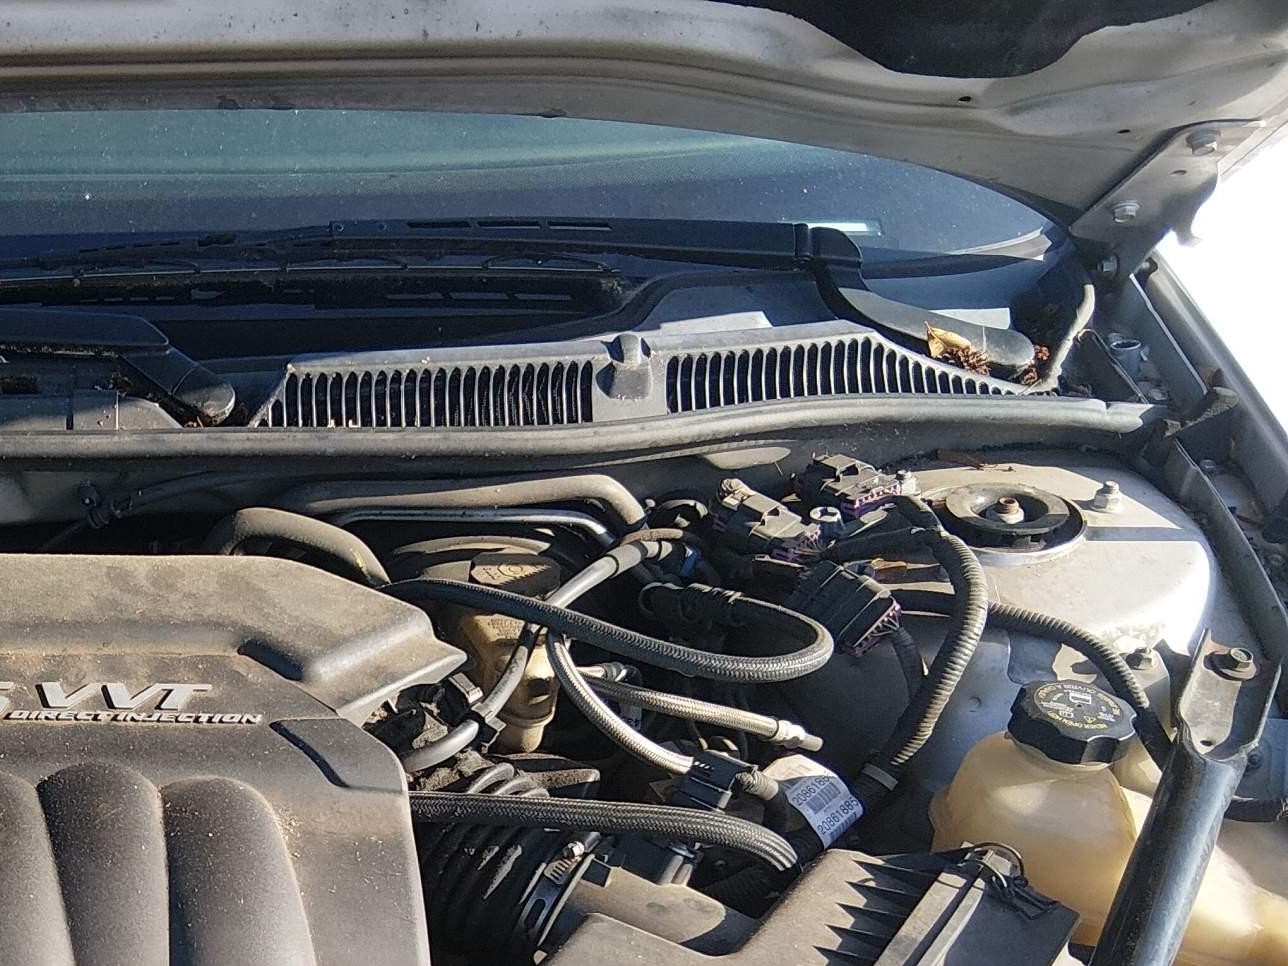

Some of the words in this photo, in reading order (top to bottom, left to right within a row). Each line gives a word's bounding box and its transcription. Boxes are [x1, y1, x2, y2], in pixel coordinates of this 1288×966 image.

[34, 681, 212, 711] VVT
[4, 710, 111, 722] DIRECT
[111, 711, 263, 725] INJECTION
[817, 796, 859, 835] 20861885
